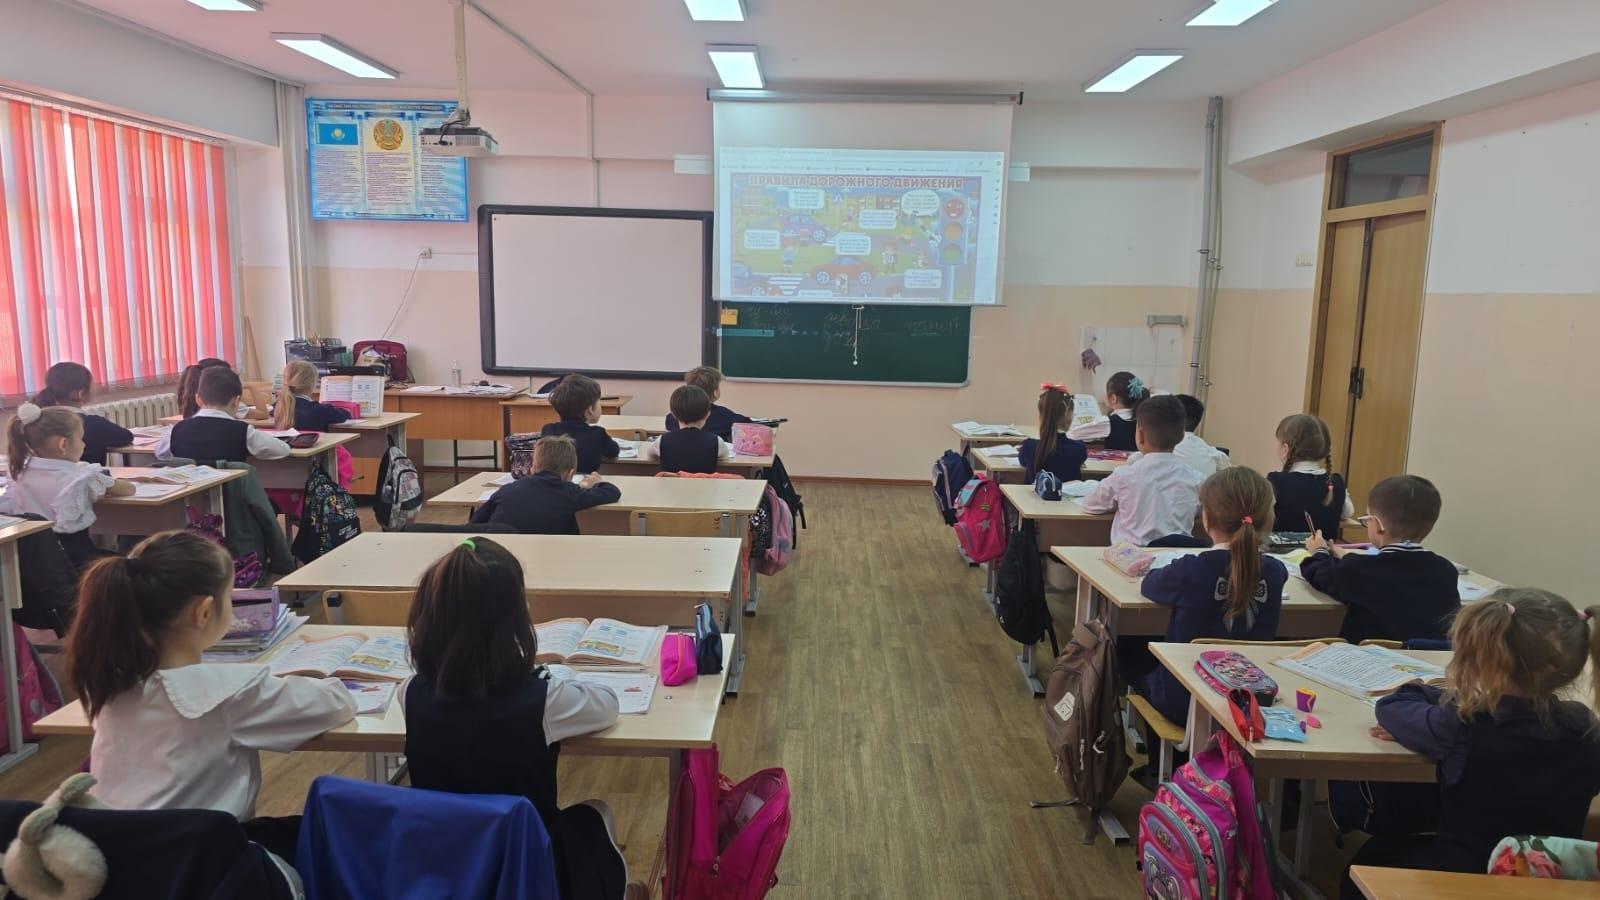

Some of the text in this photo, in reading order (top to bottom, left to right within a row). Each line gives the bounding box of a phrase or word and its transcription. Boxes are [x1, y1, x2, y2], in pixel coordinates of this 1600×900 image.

[750, 175, 963, 189] ПРАВИЛА ДОРОЖНОГО ДВИЖЕНИЯ
